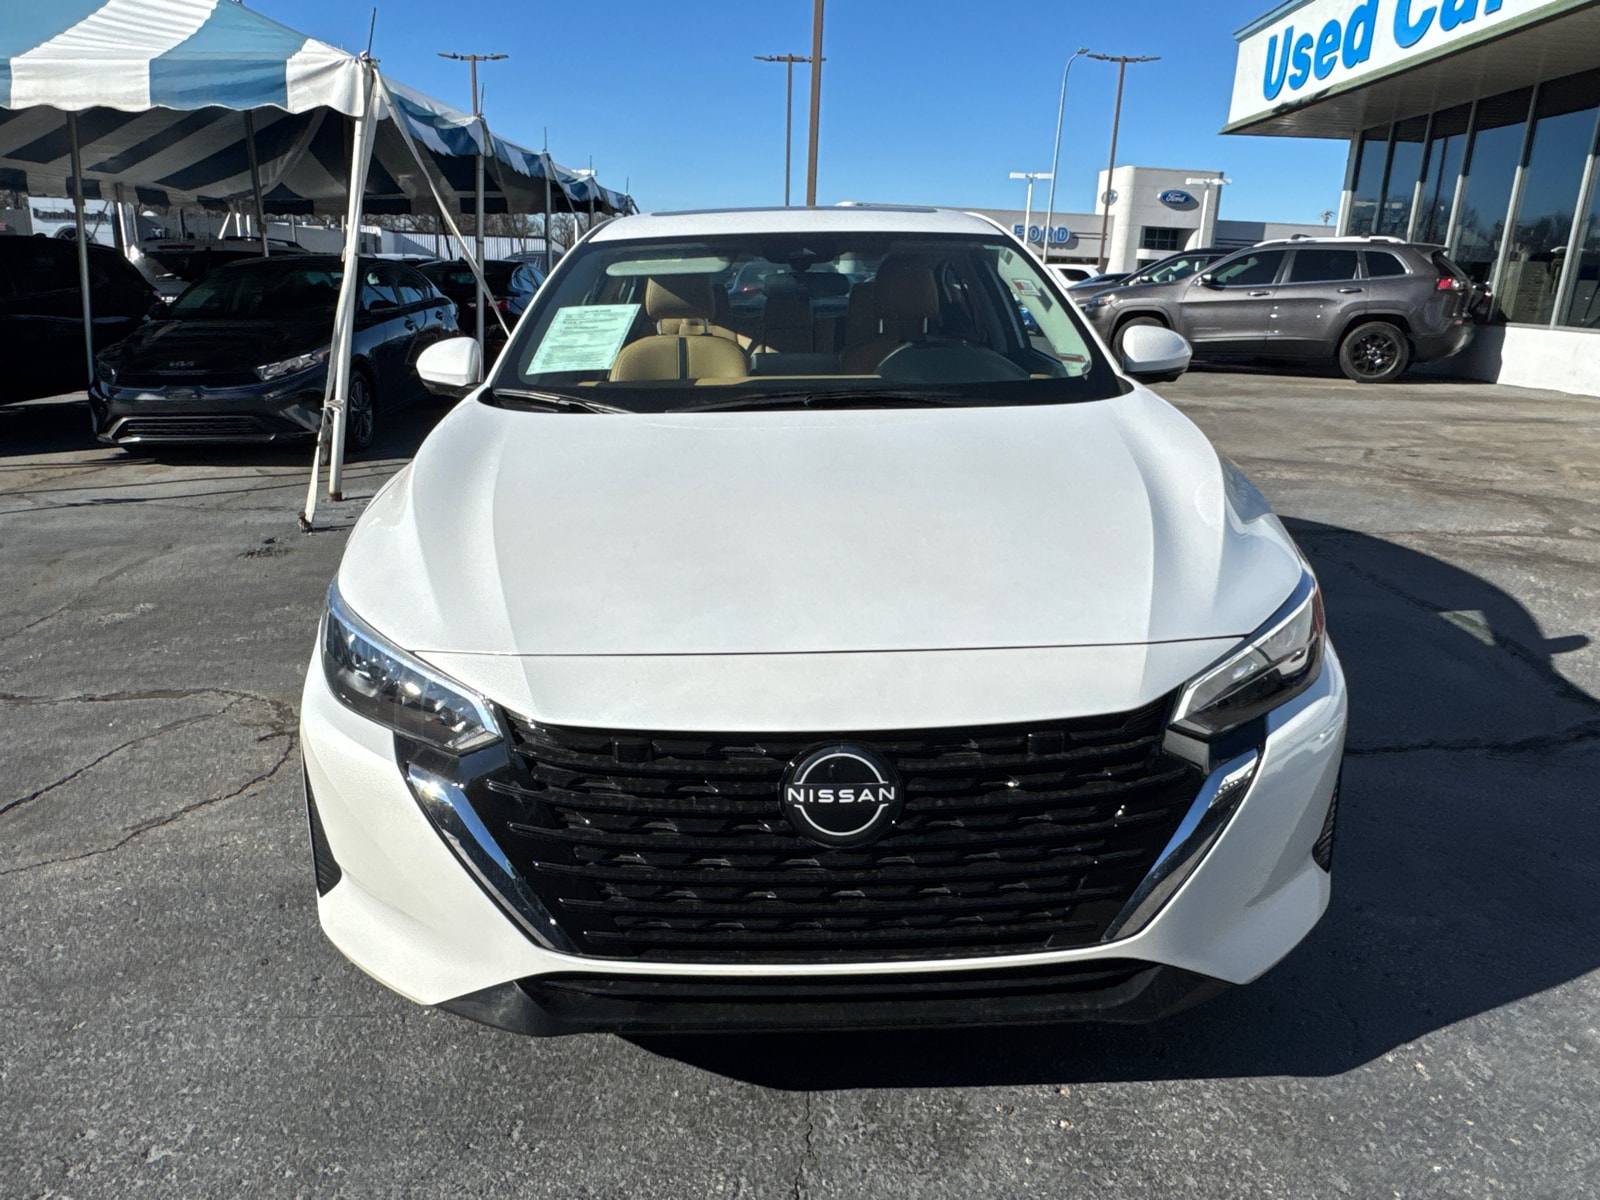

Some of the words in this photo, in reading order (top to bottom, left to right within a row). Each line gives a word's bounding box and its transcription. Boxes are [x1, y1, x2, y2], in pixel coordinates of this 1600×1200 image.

[1263, 0, 1379, 101] Used
[1393, 0, 1502, 49] Ca
[1012, 224, 1070, 243] FORD
[787, 786, 895, 803] NISSAN
